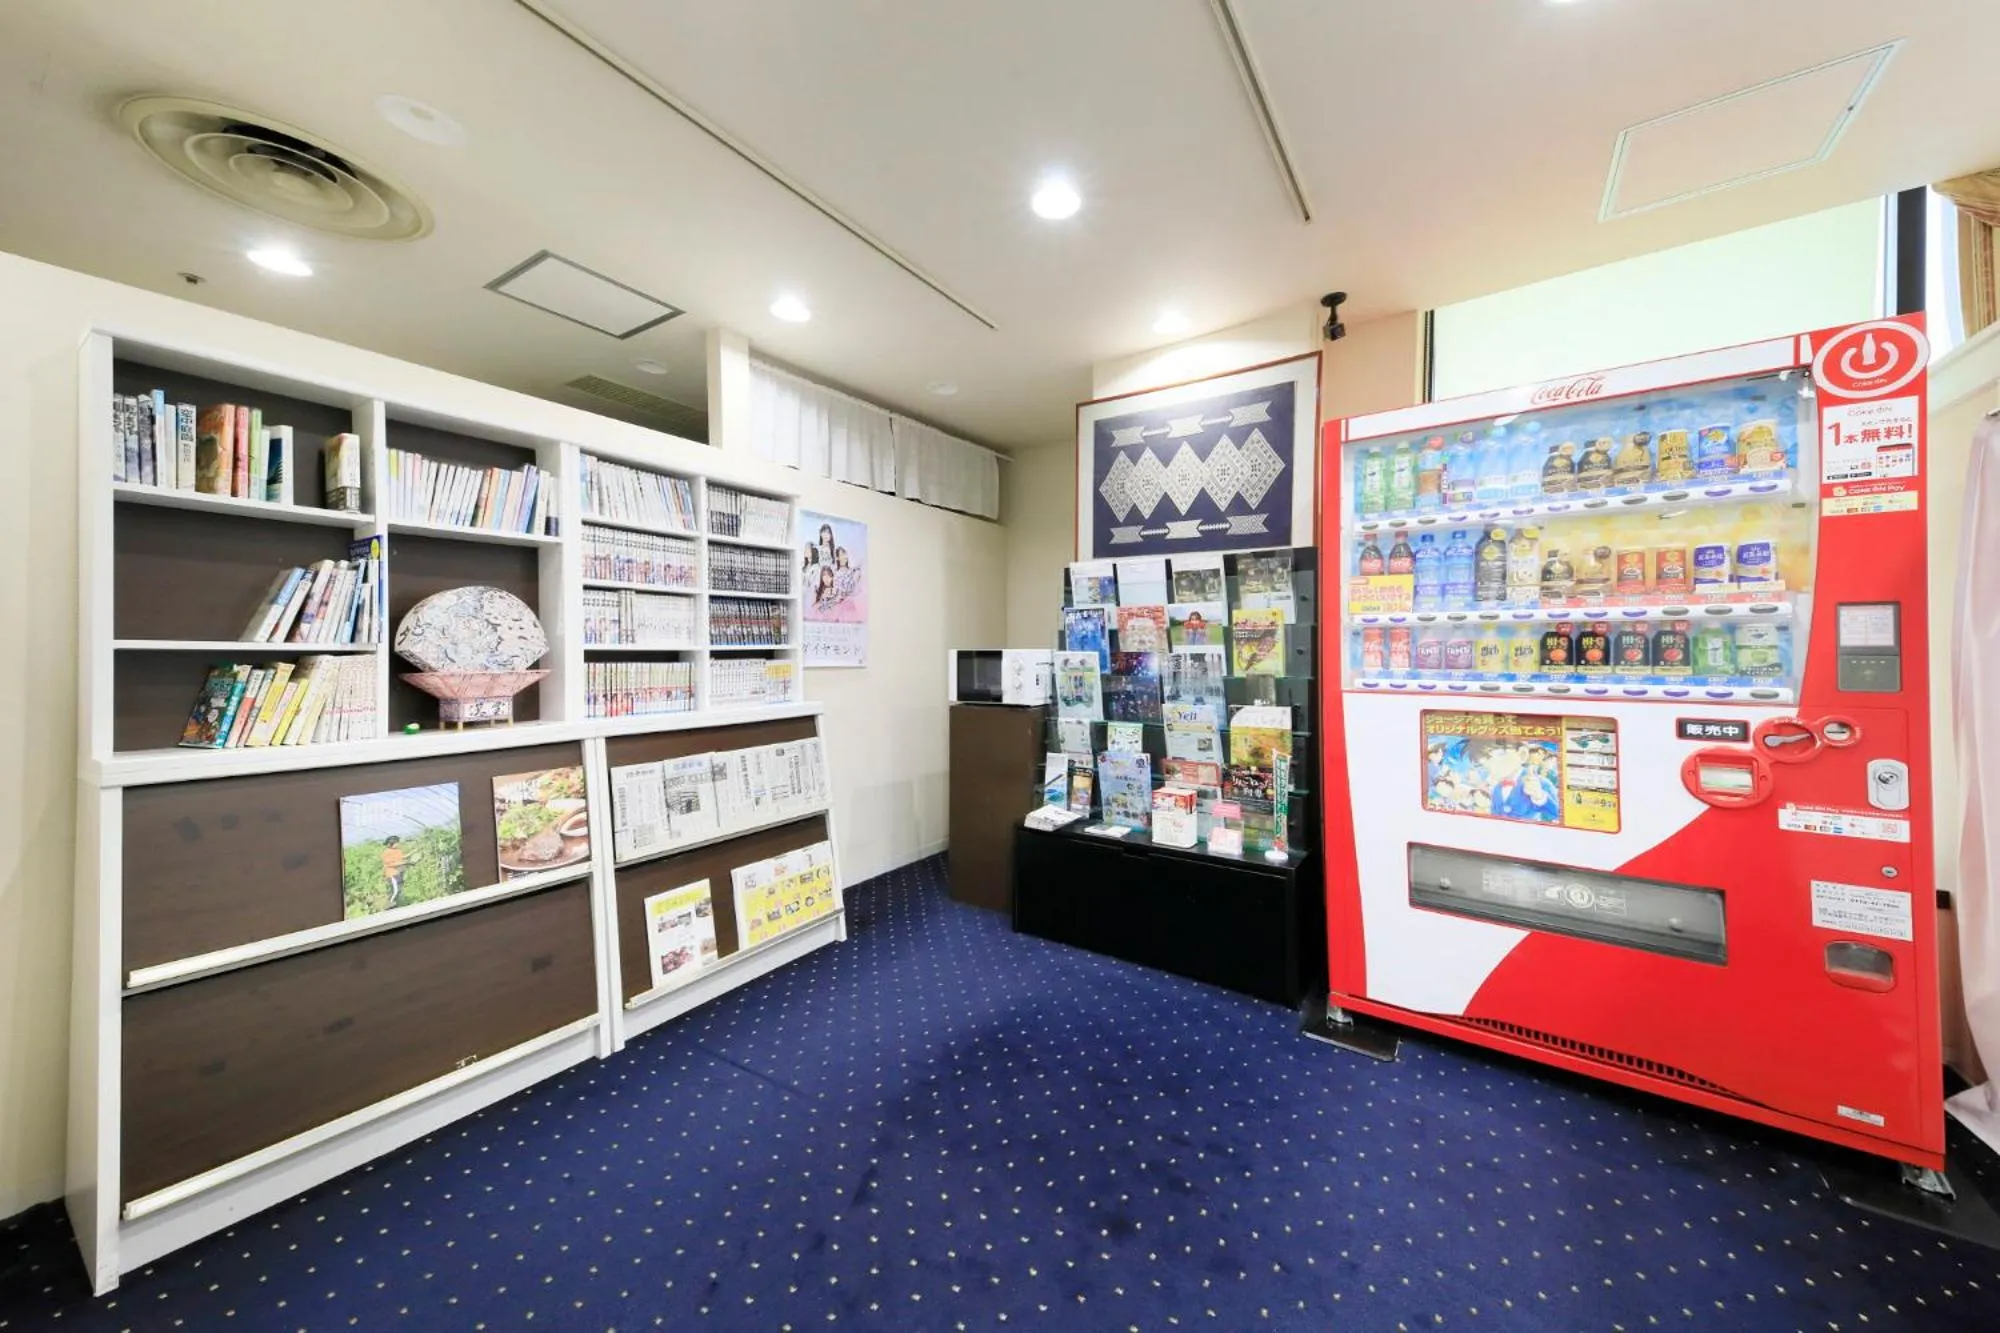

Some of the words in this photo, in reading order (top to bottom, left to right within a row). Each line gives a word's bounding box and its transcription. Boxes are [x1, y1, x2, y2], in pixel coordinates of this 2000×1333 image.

[1530, 376, 1606, 405] Coca-Cola
[1686, 722, 1740, 737] 販売中
